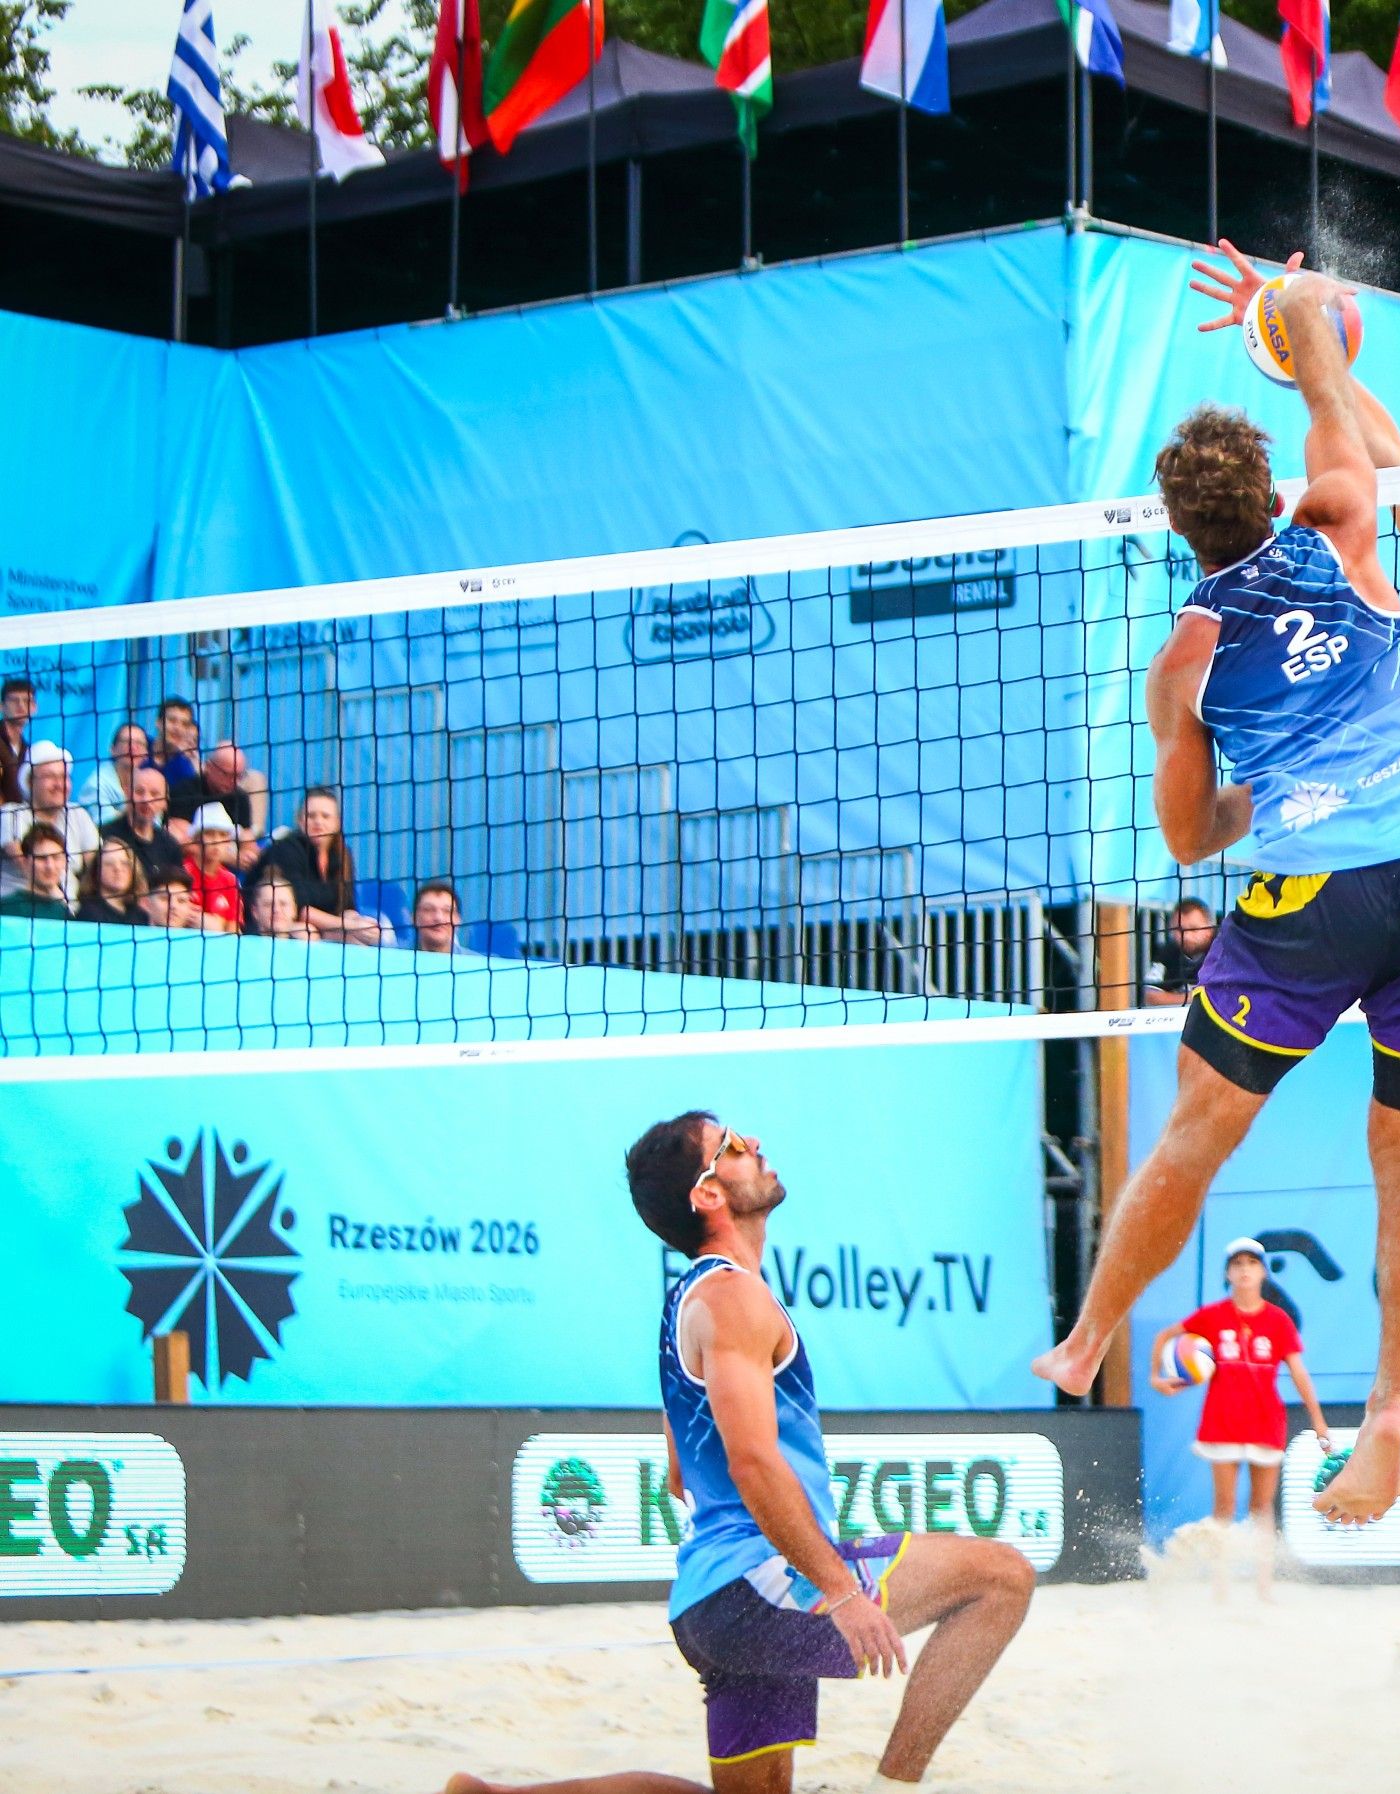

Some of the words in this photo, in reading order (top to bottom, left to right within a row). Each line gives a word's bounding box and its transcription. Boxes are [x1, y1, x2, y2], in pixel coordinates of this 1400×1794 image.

[1262, 288, 1294, 364] MIKASA
[1273, 609, 1328, 657] 2
[1281, 635, 1349, 684] ESP
[1231, 995, 1252, 1028] 2
[328, 1213, 461, 1254] Rzeszów
[470, 1219, 541, 1255] 2026
